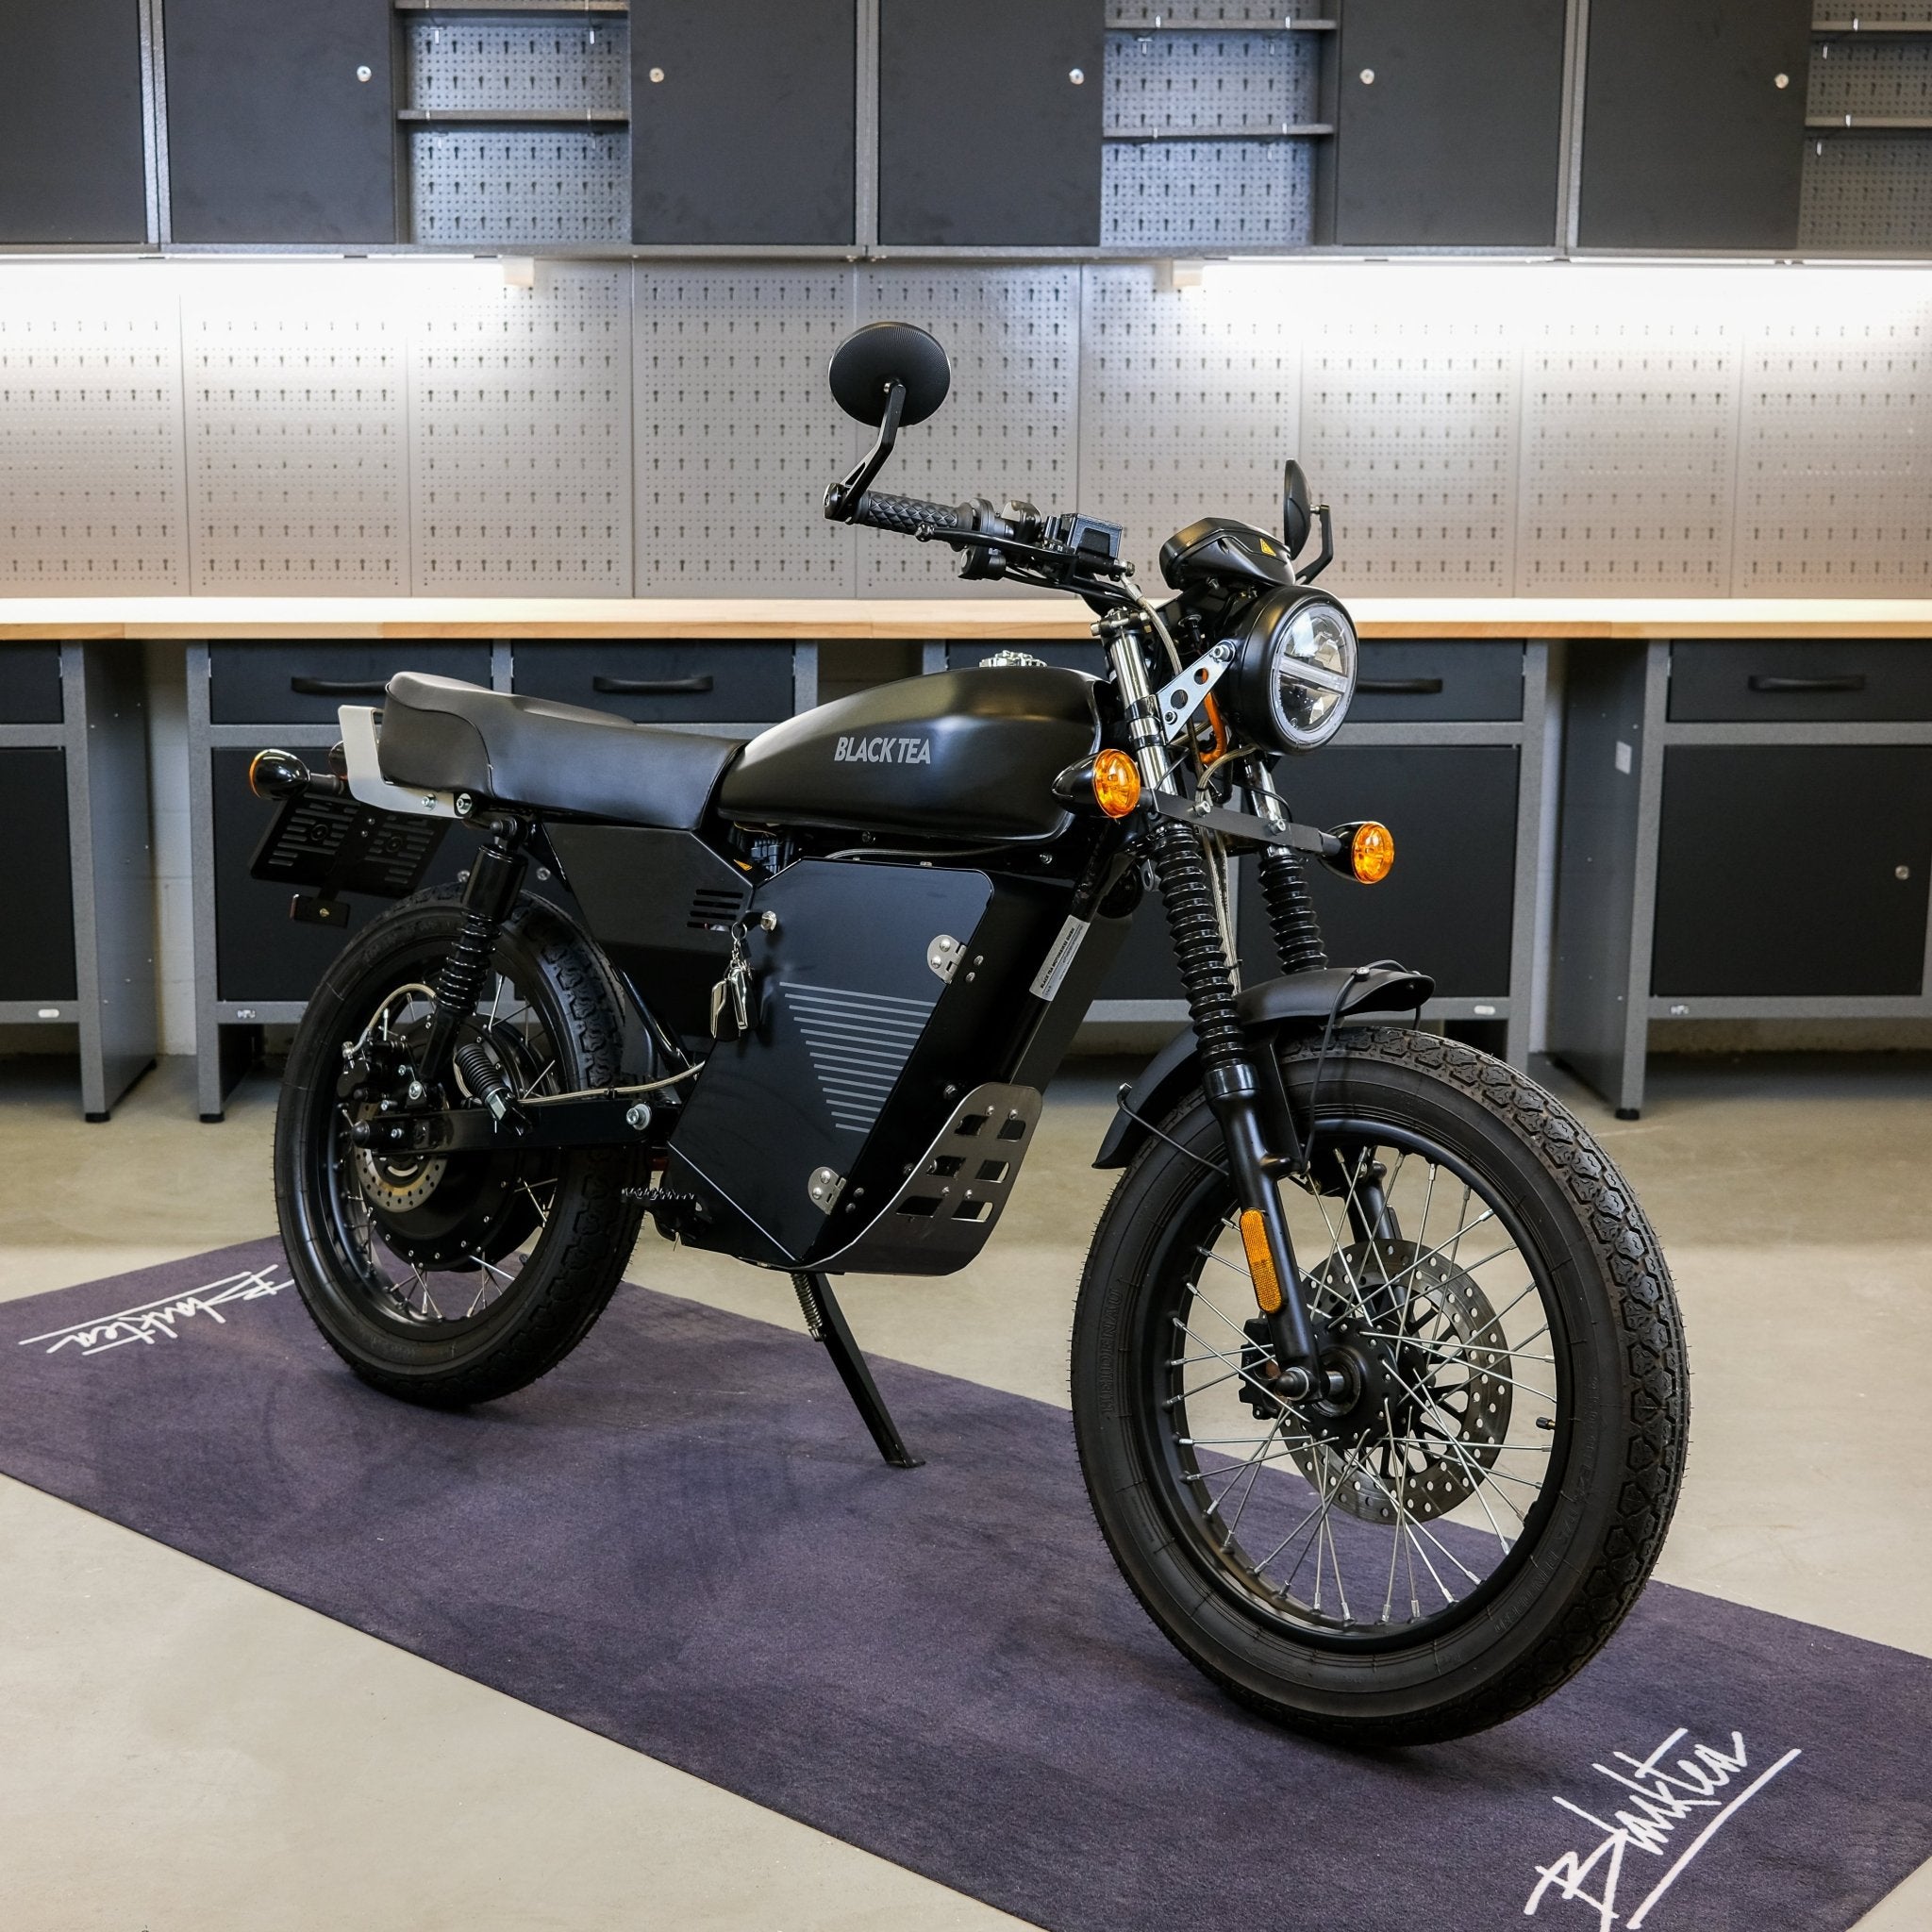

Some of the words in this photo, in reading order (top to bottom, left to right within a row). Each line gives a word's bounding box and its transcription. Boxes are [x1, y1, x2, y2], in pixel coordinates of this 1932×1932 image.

[834, 736, 896, 763] BLACK
[897, 738, 931, 764] TEA
[1041, 974, 1049, 989] BLACK
[1099, 1288, 1124, 1415] HEIDENAU
